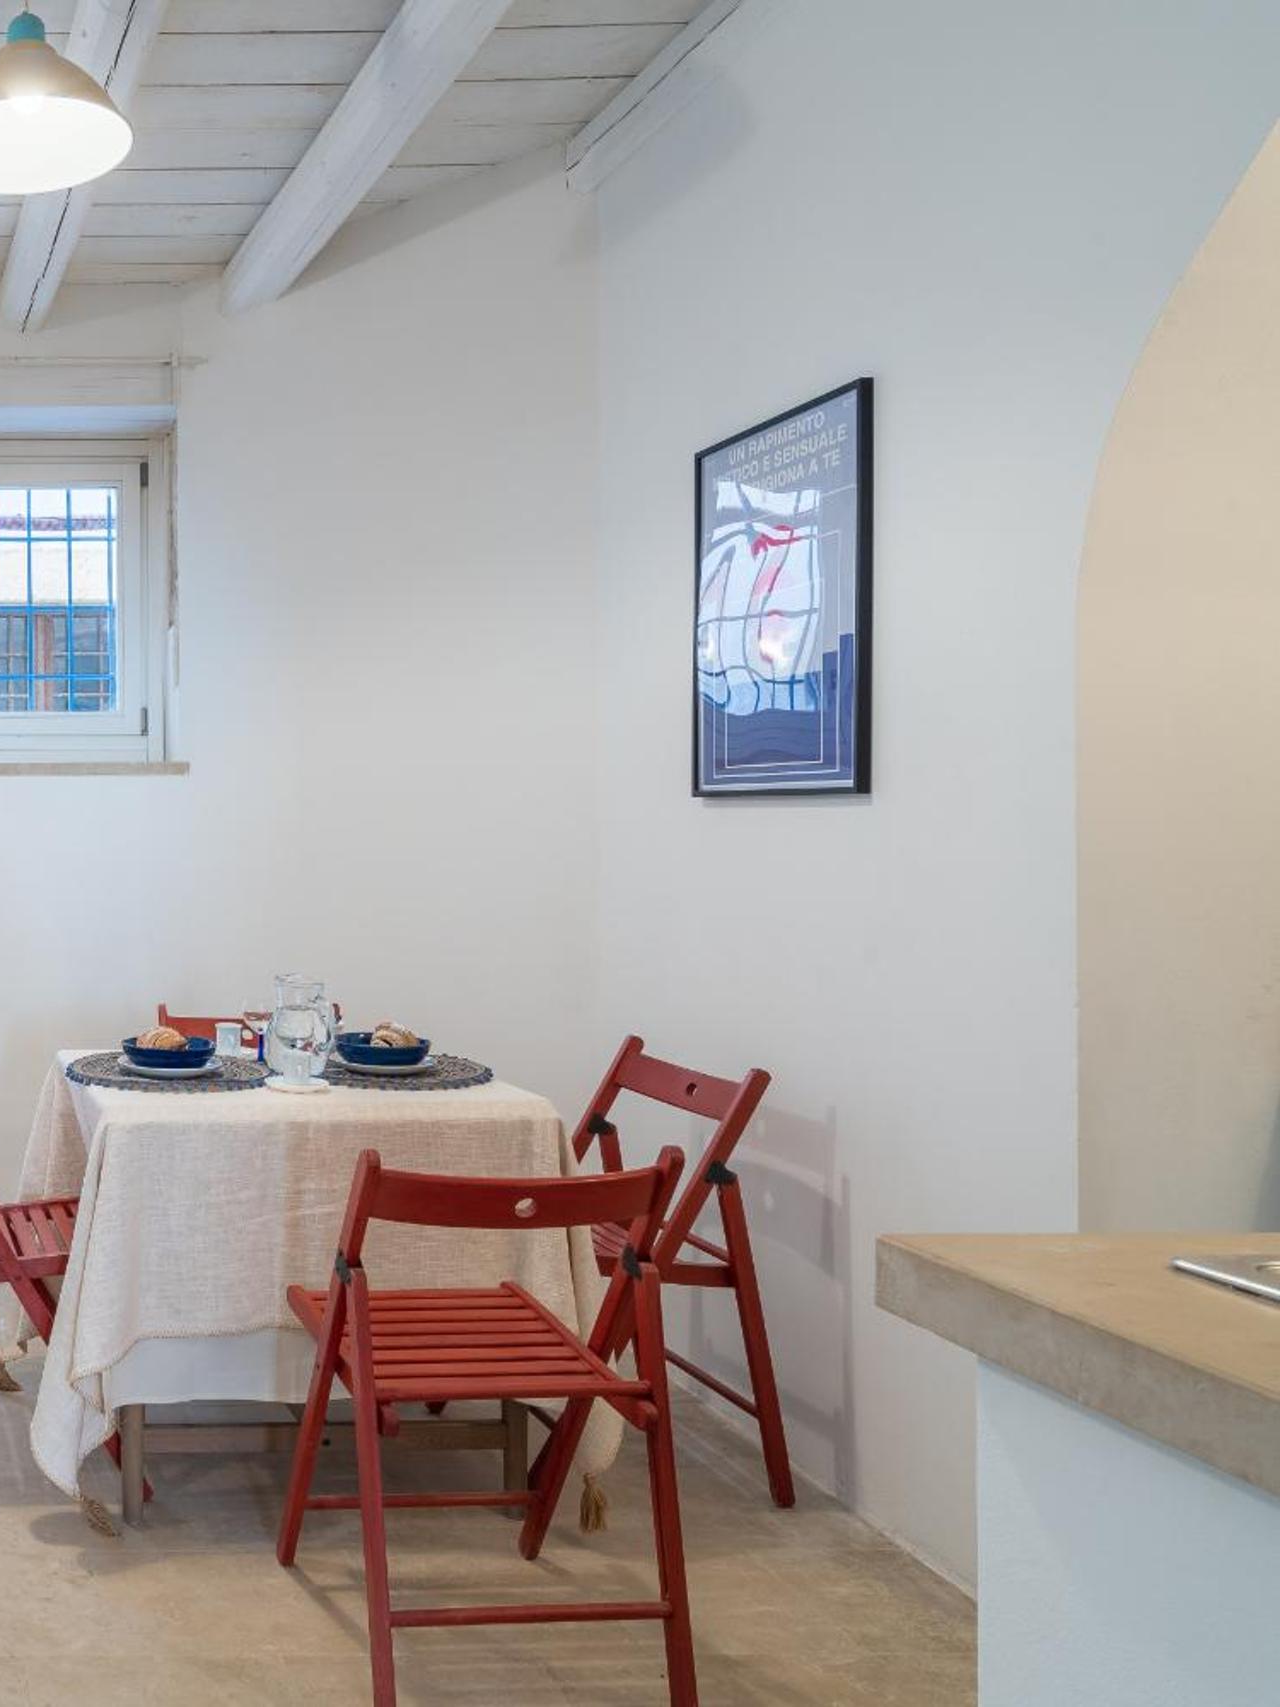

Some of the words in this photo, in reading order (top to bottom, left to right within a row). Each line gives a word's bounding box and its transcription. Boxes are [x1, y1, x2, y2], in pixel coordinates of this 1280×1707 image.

[728, 446, 745, 465] UN
[748, 411, 826, 457] RAPIMENTO
[763, 454, 770, 472] E
[773, 423, 848, 468] SENSUALE
[808, 458, 819, 477] A
[823, 449, 841, 470] TE
